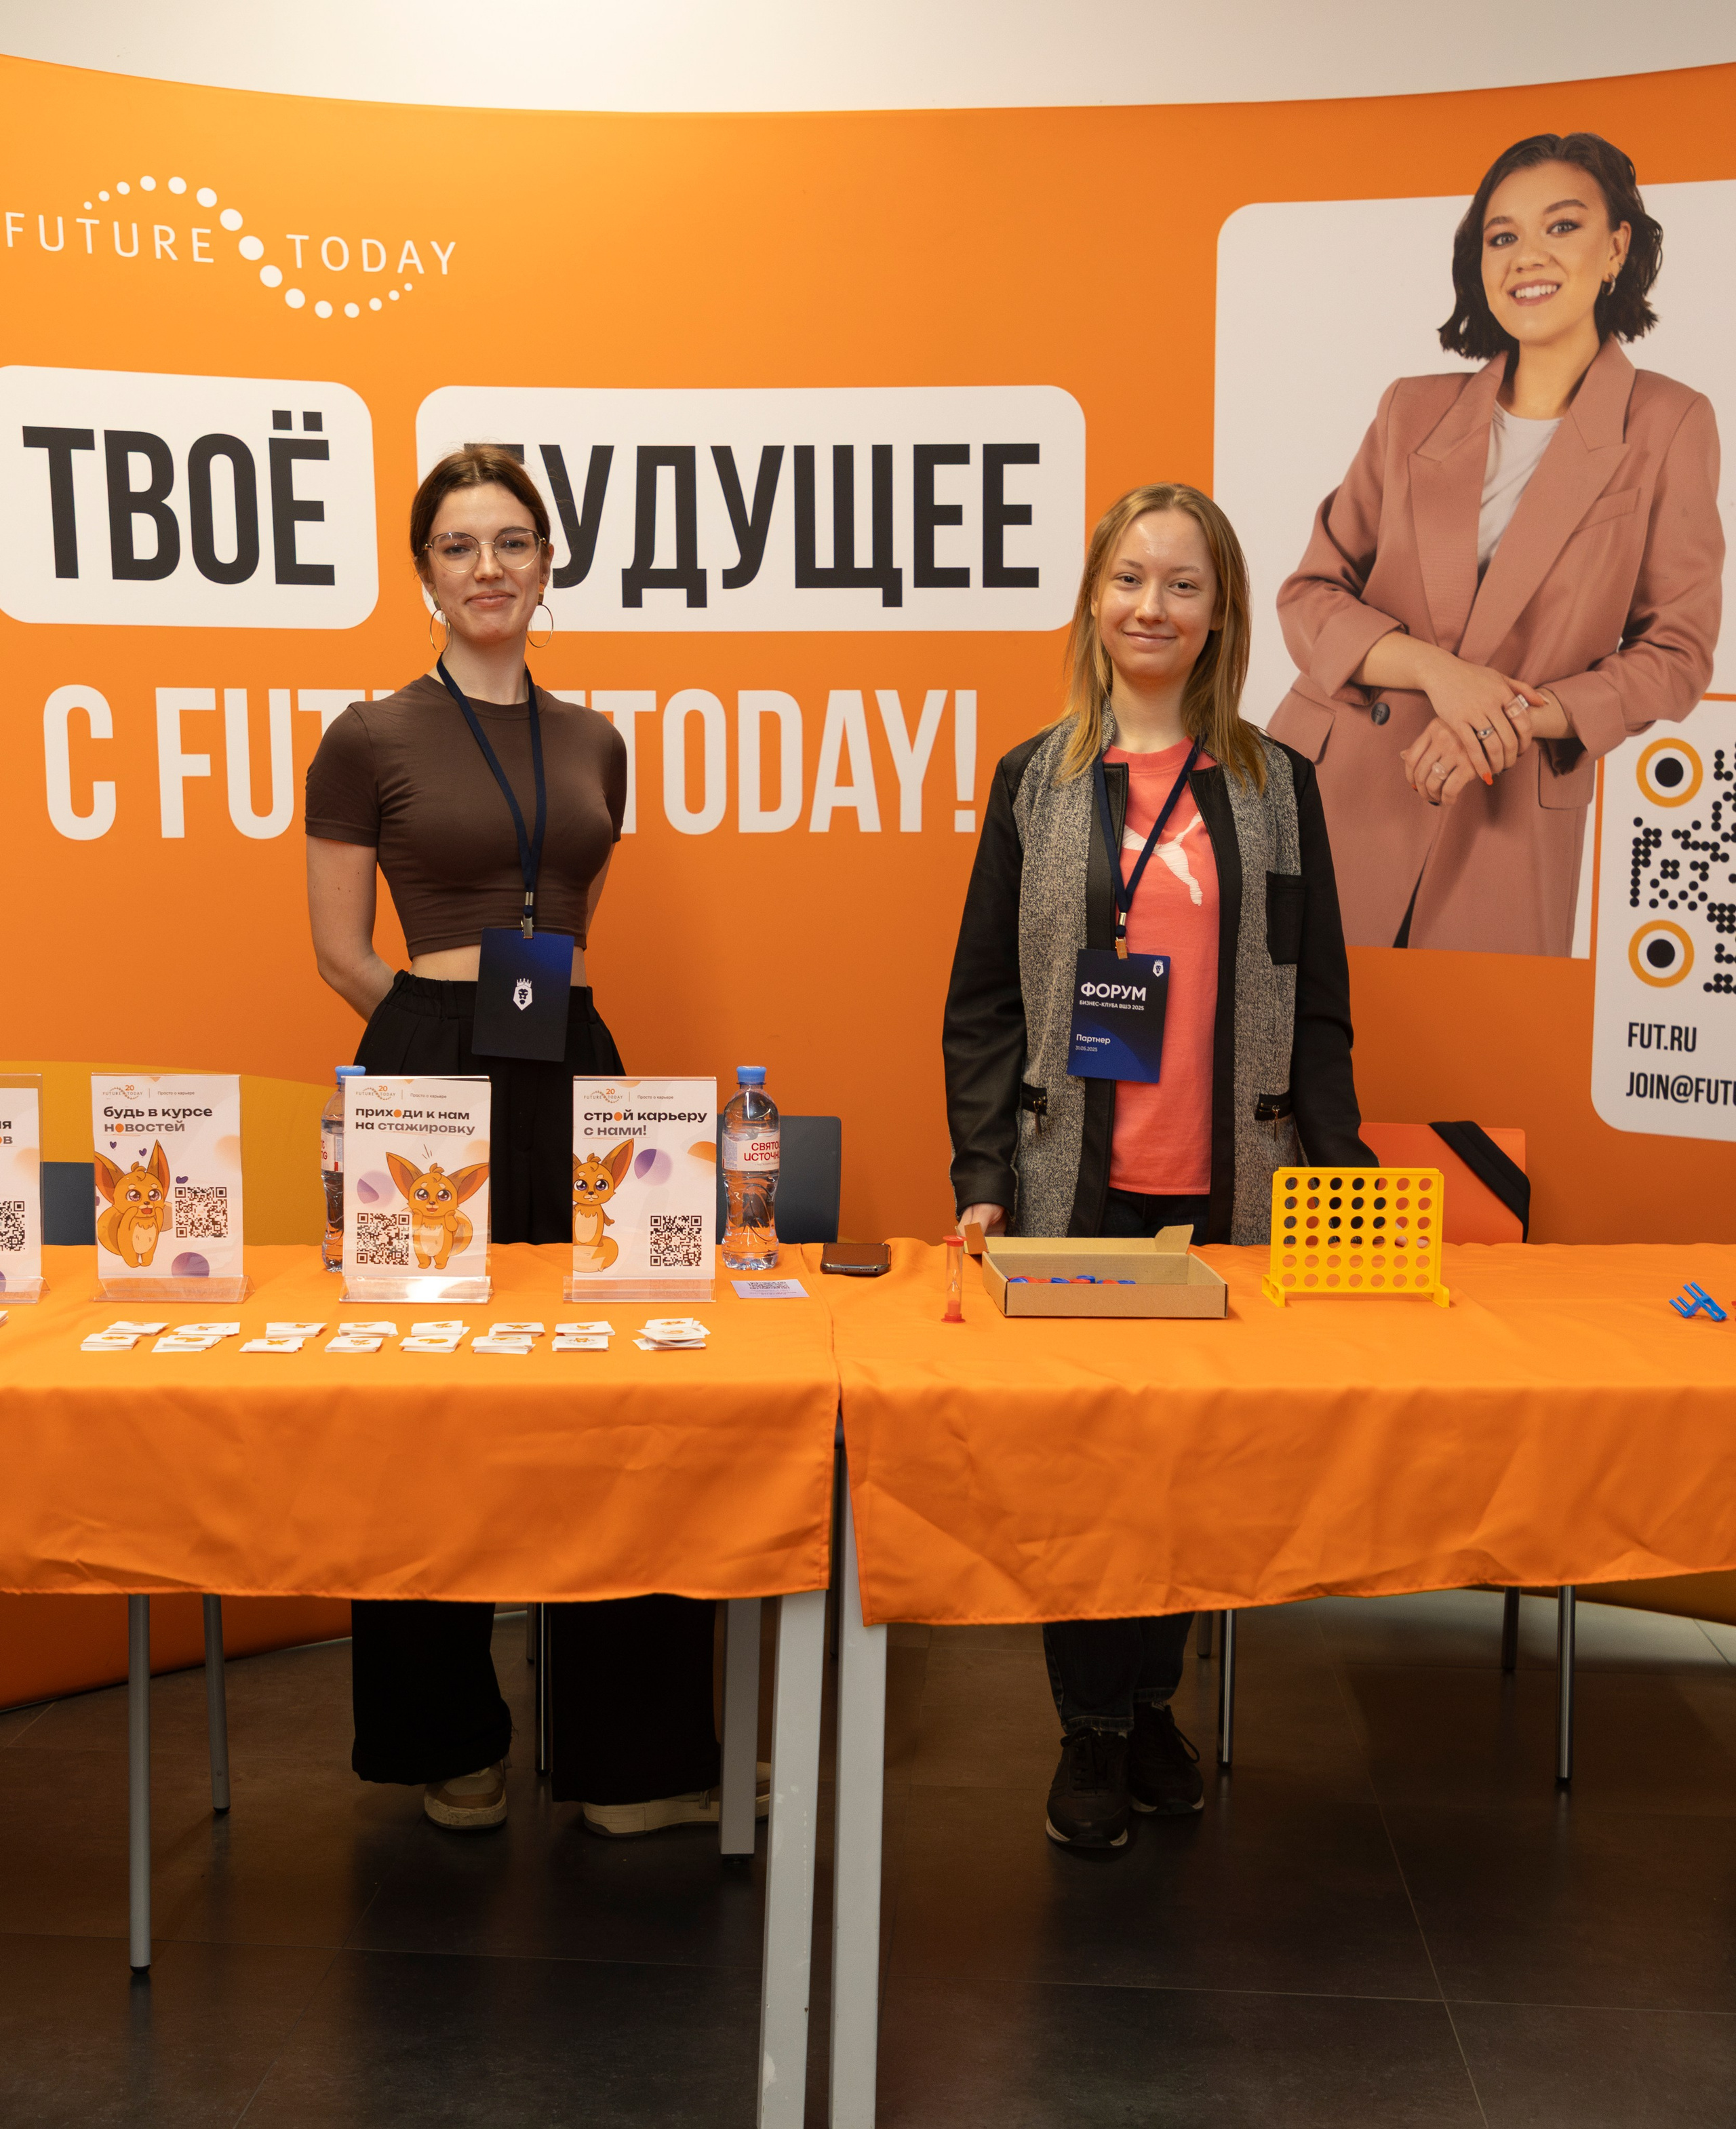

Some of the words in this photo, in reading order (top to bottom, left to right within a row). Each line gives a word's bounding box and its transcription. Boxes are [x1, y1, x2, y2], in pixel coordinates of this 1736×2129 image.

[5, 211, 214, 264] FUTURE
[285, 233, 457, 275] TODAY
[22, 410, 336, 587] ТВОЁ
[464, 442, 1040, 608] УДУЩЕЕ
[1080, 981, 1147, 1002] ФОРУМ
[1079, 1000, 1118, 1009] БИЗНЕС-КЛУБА
[1076, 1034, 1111, 1045] Партнер
[1628, 1021, 1697, 1053] FUT.RU
[103, 1106, 145, 1119] будь
[148, 1108, 158, 1117] в
[161, 1108, 213, 1119] курсе
[355, 1108, 423, 1119] приходи
[427, 1110, 435, 1119] к
[438, 1111, 470, 1120] нам
[583, 1109, 633, 1122] строй
[637, 1112, 707, 1123] карьеру
[104, 1120, 185, 1133] новостей
[355, 1121, 374, 1130] на
[378, 1122, 475, 1136] стажировку
[583, 1126, 593, 1136] с
[597, 1125, 646, 1136] нами!
